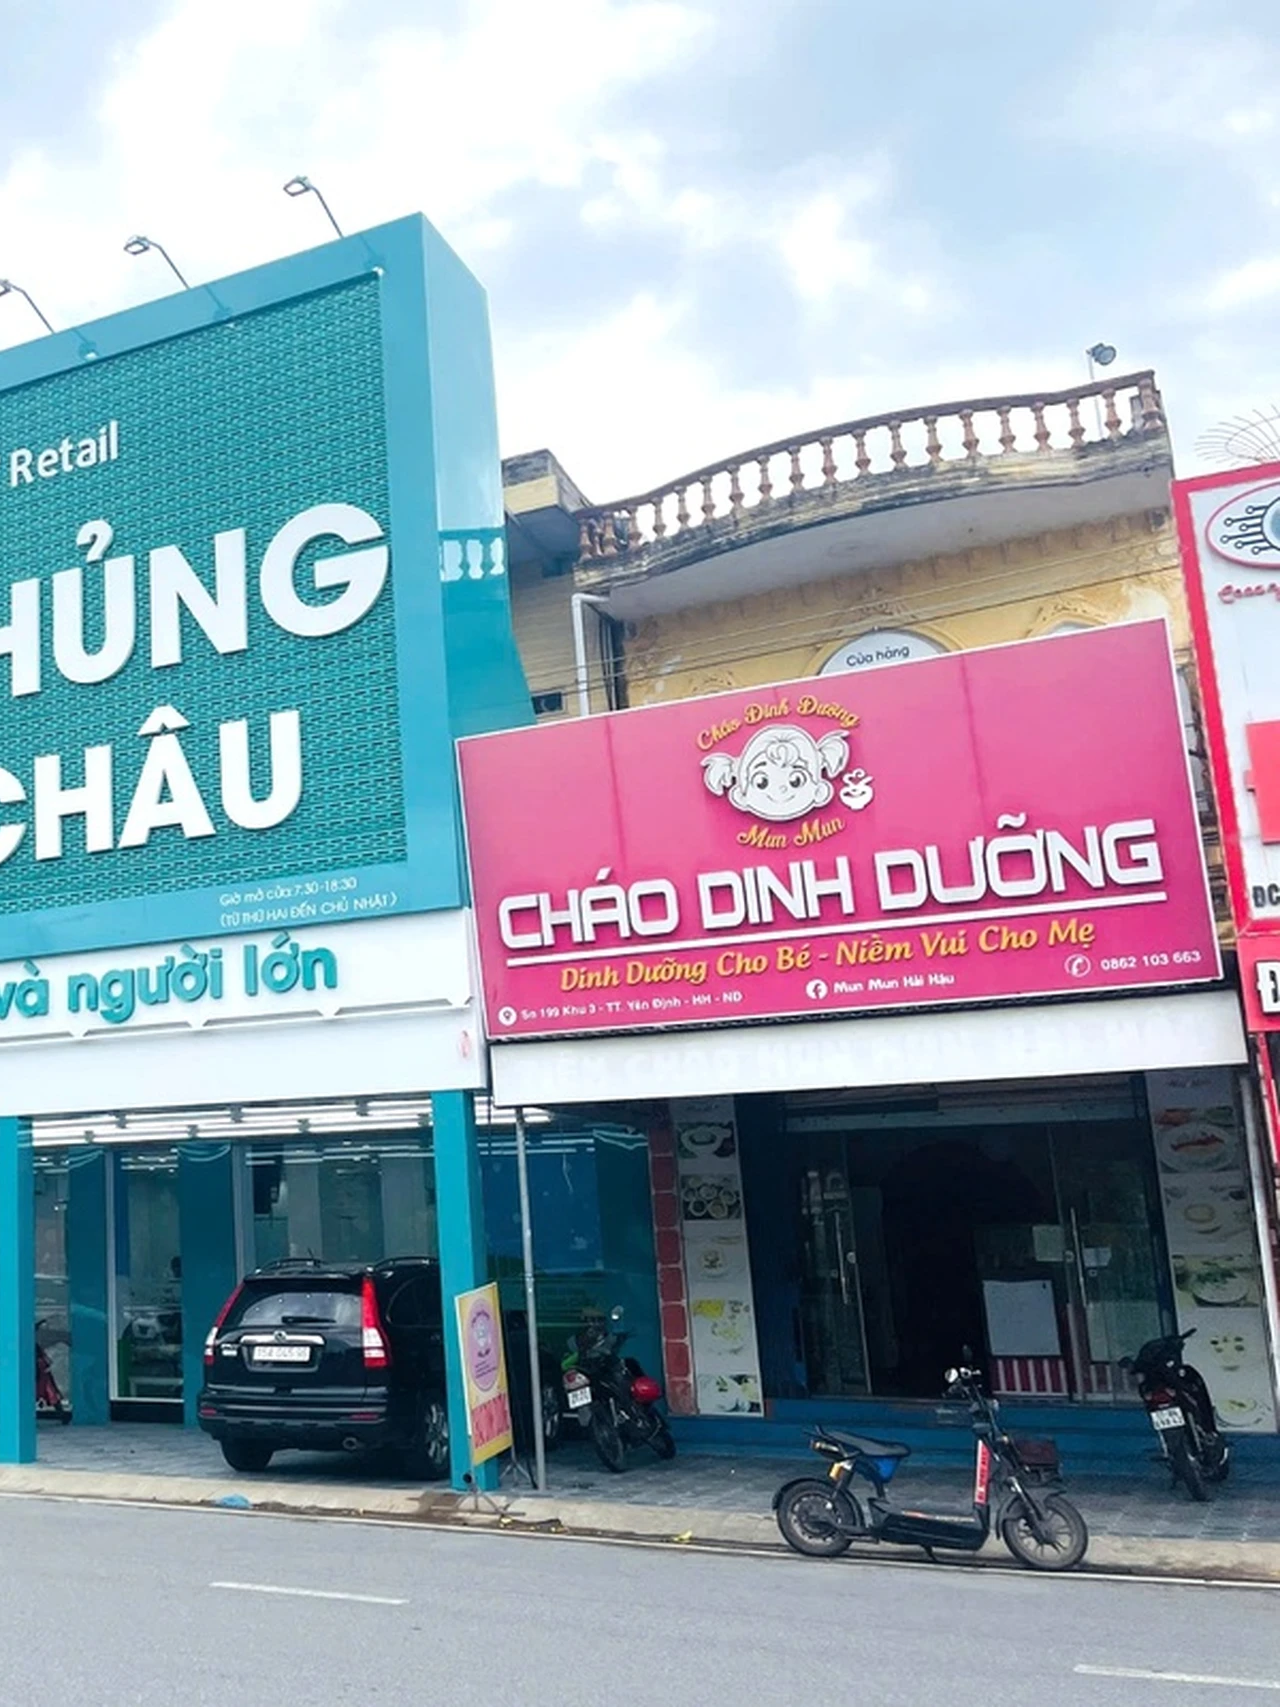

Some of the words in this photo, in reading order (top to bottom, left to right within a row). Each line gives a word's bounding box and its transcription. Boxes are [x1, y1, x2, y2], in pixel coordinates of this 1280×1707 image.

[9, 420, 120, 487] Retail
[846, 650, 873, 667] Cửa
[875, 645, 910, 662] hàng
[736, 824, 788, 849] Mun
[793, 817, 845, 847] Mun
[498, 867, 680, 950] CHÁO
[697, 855, 855, 930] DINH
[874, 813, 1165, 913] DƯỠNG
[220, 891, 241, 907] Giờ
[243, 887, 265, 904] mở
[290, 900, 317, 920] ĐẾN
[321, 895, 349, 915] CHỦ
[560, 965, 621, 992] Dinh
[626, 957, 708, 985] Dưỡng
[716, 950, 768, 977] Cho
[776, 943, 812, 972] Bé
[835, 932, 914, 966] Niềm
[919, 929, 968, 958] Vui
[979, 923, 1039, 952] Cho
[1048, 918, 1096, 952] Mẹ
[1100, 955, 1138, 971] 0862
[1142, 953, 1170, 968] 103
[68, 943, 224, 1024] người
[243, 930, 339, 996] lớn
[833, 979, 865, 993] Mun
[868, 977, 900, 992] Mun
[562, 1003, 587, 1017] Khu
